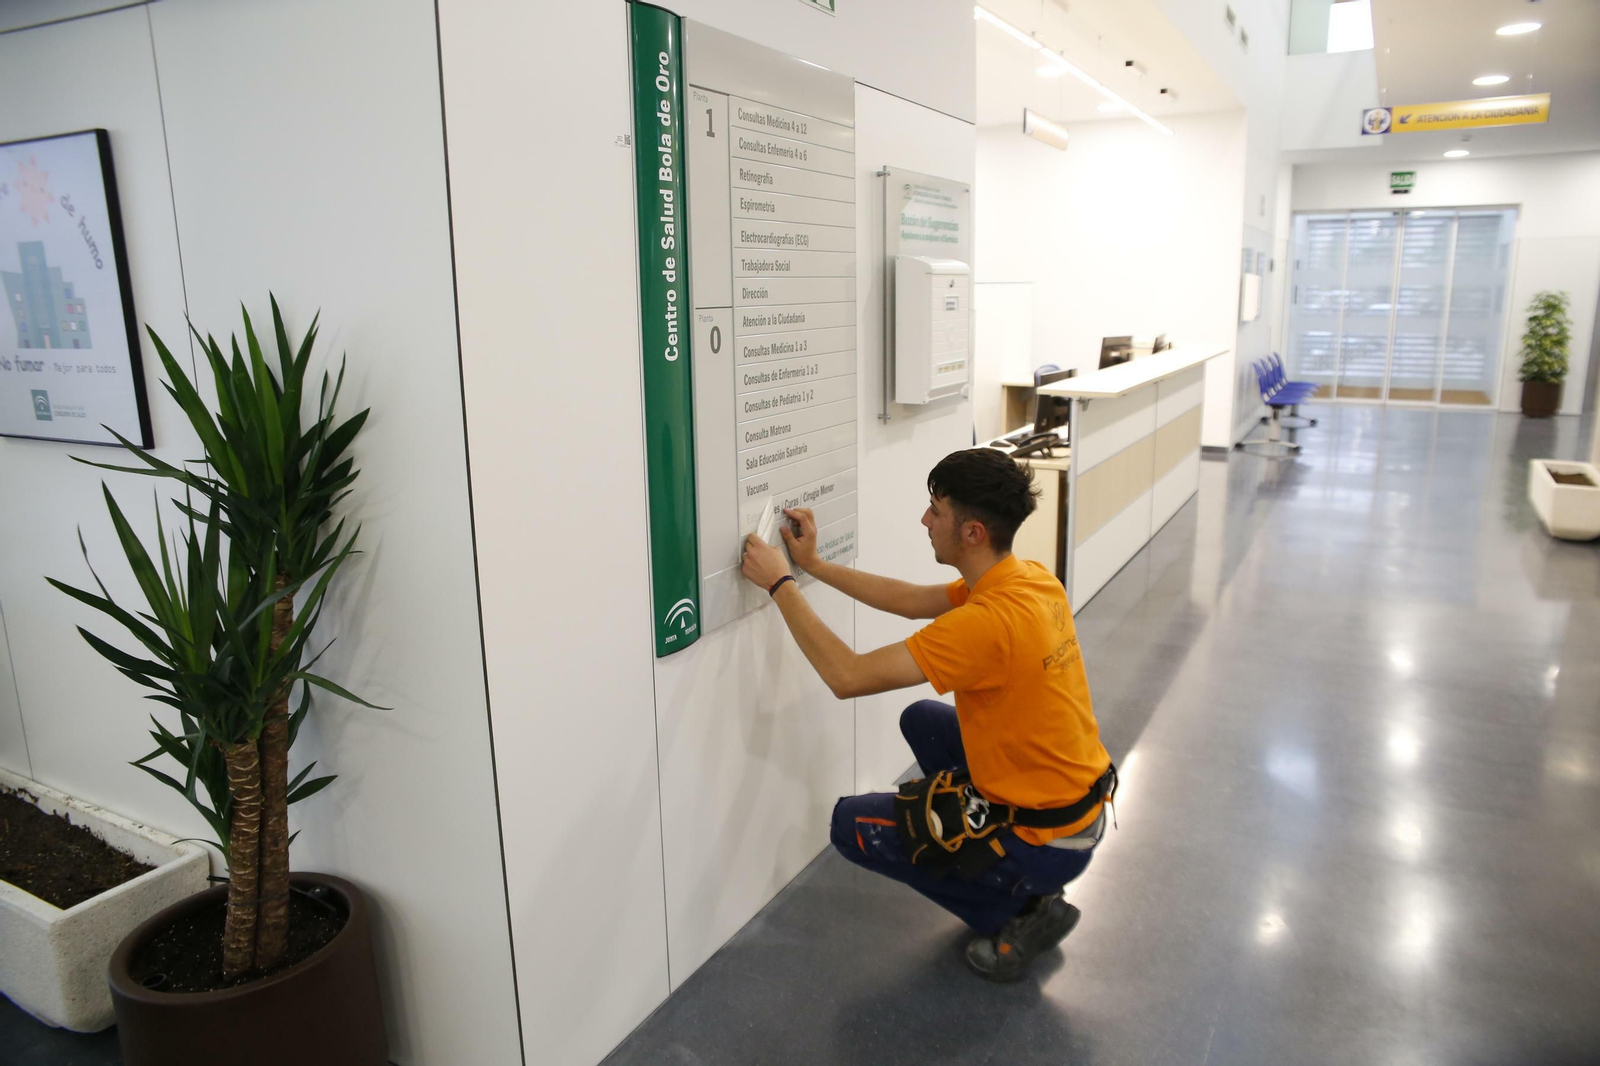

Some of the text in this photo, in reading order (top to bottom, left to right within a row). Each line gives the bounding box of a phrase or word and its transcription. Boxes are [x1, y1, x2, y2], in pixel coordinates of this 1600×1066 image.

[706, 108, 715, 138] 1
[738, 107, 807, 135] Consultas Medicina 4 a 12
[739, 137, 766, 154] Consultas
[794, 148, 798, 159] 4
[799, 152, 802, 160] a
[804, 150, 807, 161] 6
[740, 168, 773, 186] Retinografía
[656, 52, 678, 362] Centro de Salud Bola de Oro
[740, 197, 775, 212] Espirometría
[60, 194, 103, 270] de humo
[741, 230, 809, 248] Electrocardiografías (ECG)
[741, 259, 790, 274] Trabajadora Social
[742, 287, 768, 299] Dirección
[743, 312, 805, 327] Atención a la Ciudadanía
[710, 326, 721, 354] 0
[743, 340, 807, 358] Consultas Medicina 1 a 3
[15, 354, 45, 372] fumar
[76, 365, 92, 373] para
[96, 365, 116, 374] todos
[744, 372, 770, 385] Consultas
[771, 370, 778, 381] de
[779, 366, 805, 380] Enfermería
[807, 365, 809, 375] 1
[815, 364, 818, 374] 3
[745, 389, 814, 413] Consultas de Pediatría 1 y 2
[745, 425, 791, 443] Consulta Matrona
[746, 443, 807, 470] Sala Educación Sanitaria
[746, 482, 769, 496] Vacunas
[785, 498, 799, 509] Curas
[803, 488, 819, 502] Cirugía
[820, 484, 834, 495] Menor
